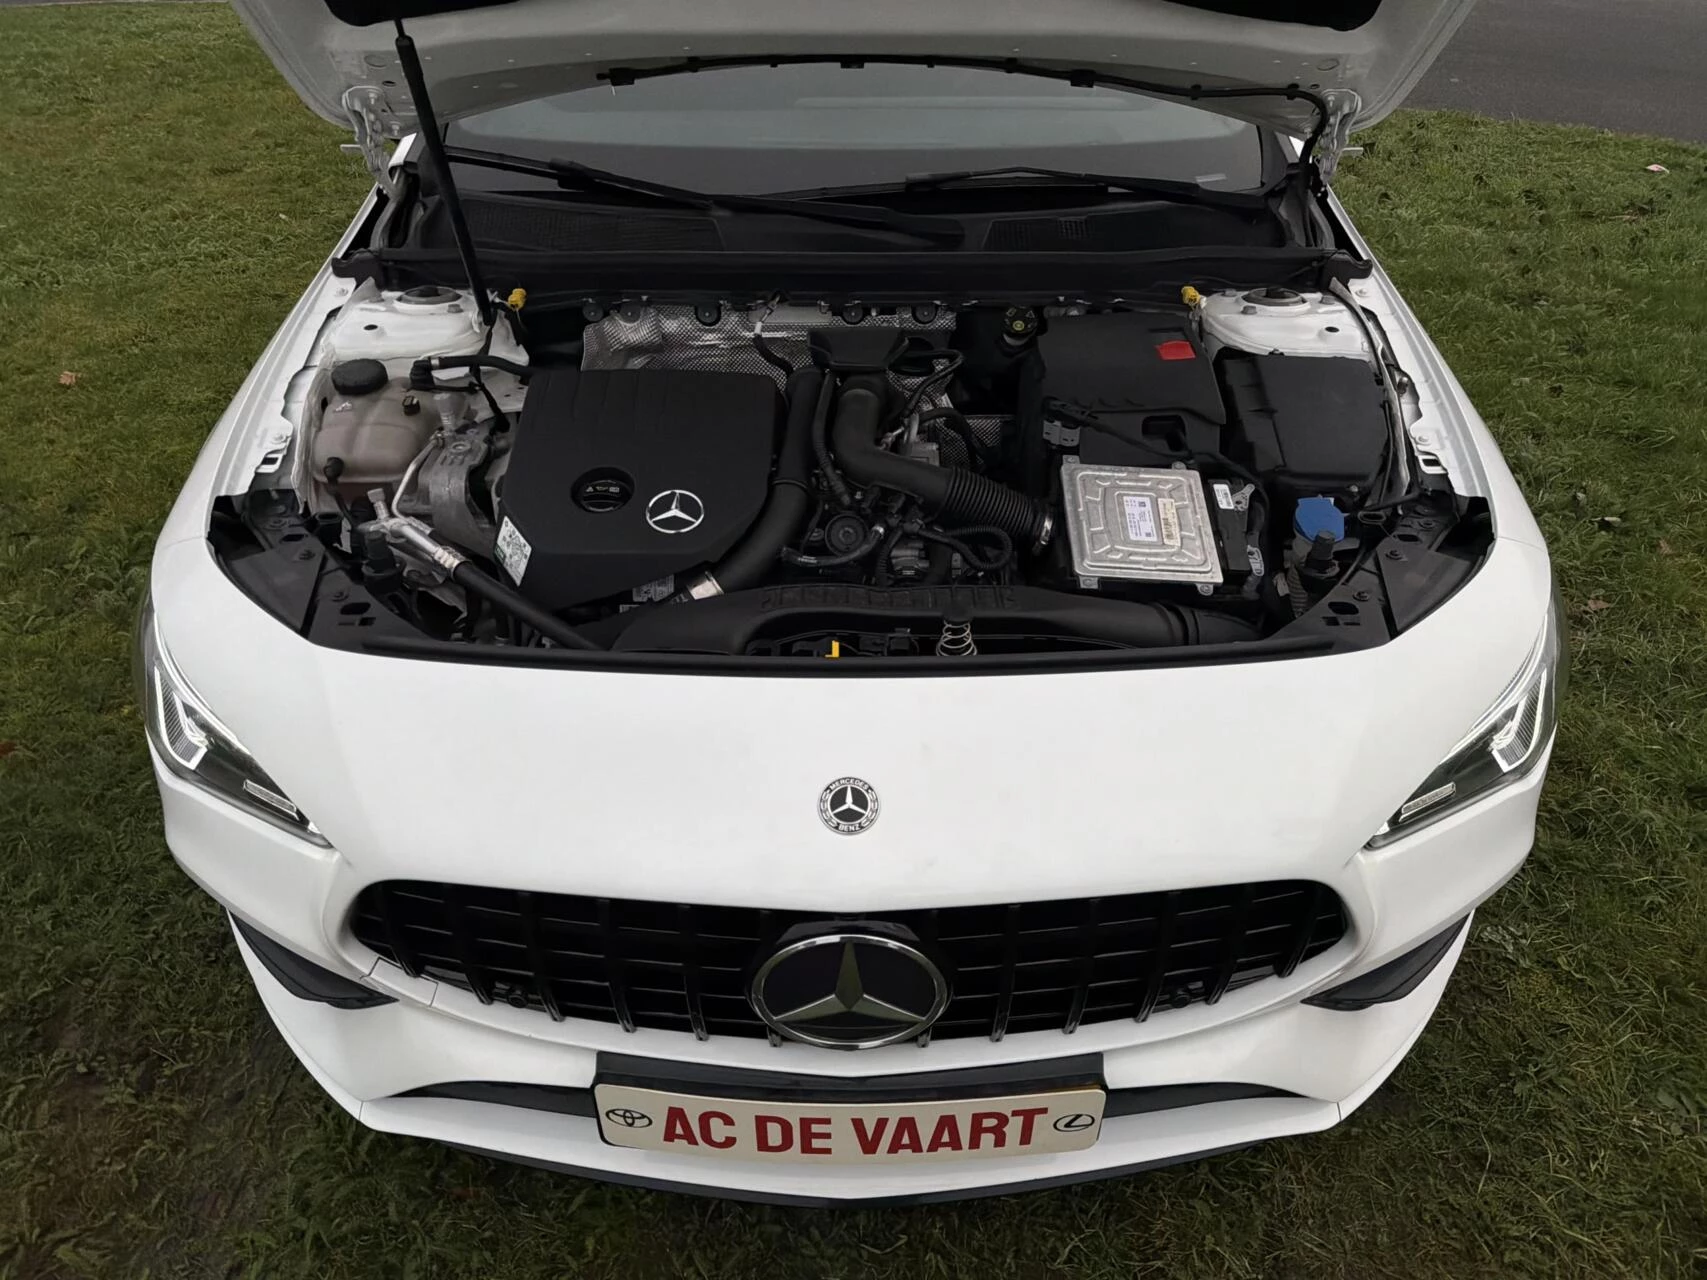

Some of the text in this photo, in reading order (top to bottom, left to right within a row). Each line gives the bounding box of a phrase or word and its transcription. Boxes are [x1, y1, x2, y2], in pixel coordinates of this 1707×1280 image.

[829, 778, 870, 791] MERCEDES
[838, 823, 861, 832] BENZ
[663, 1106, 1048, 1155] AC DE VAART
